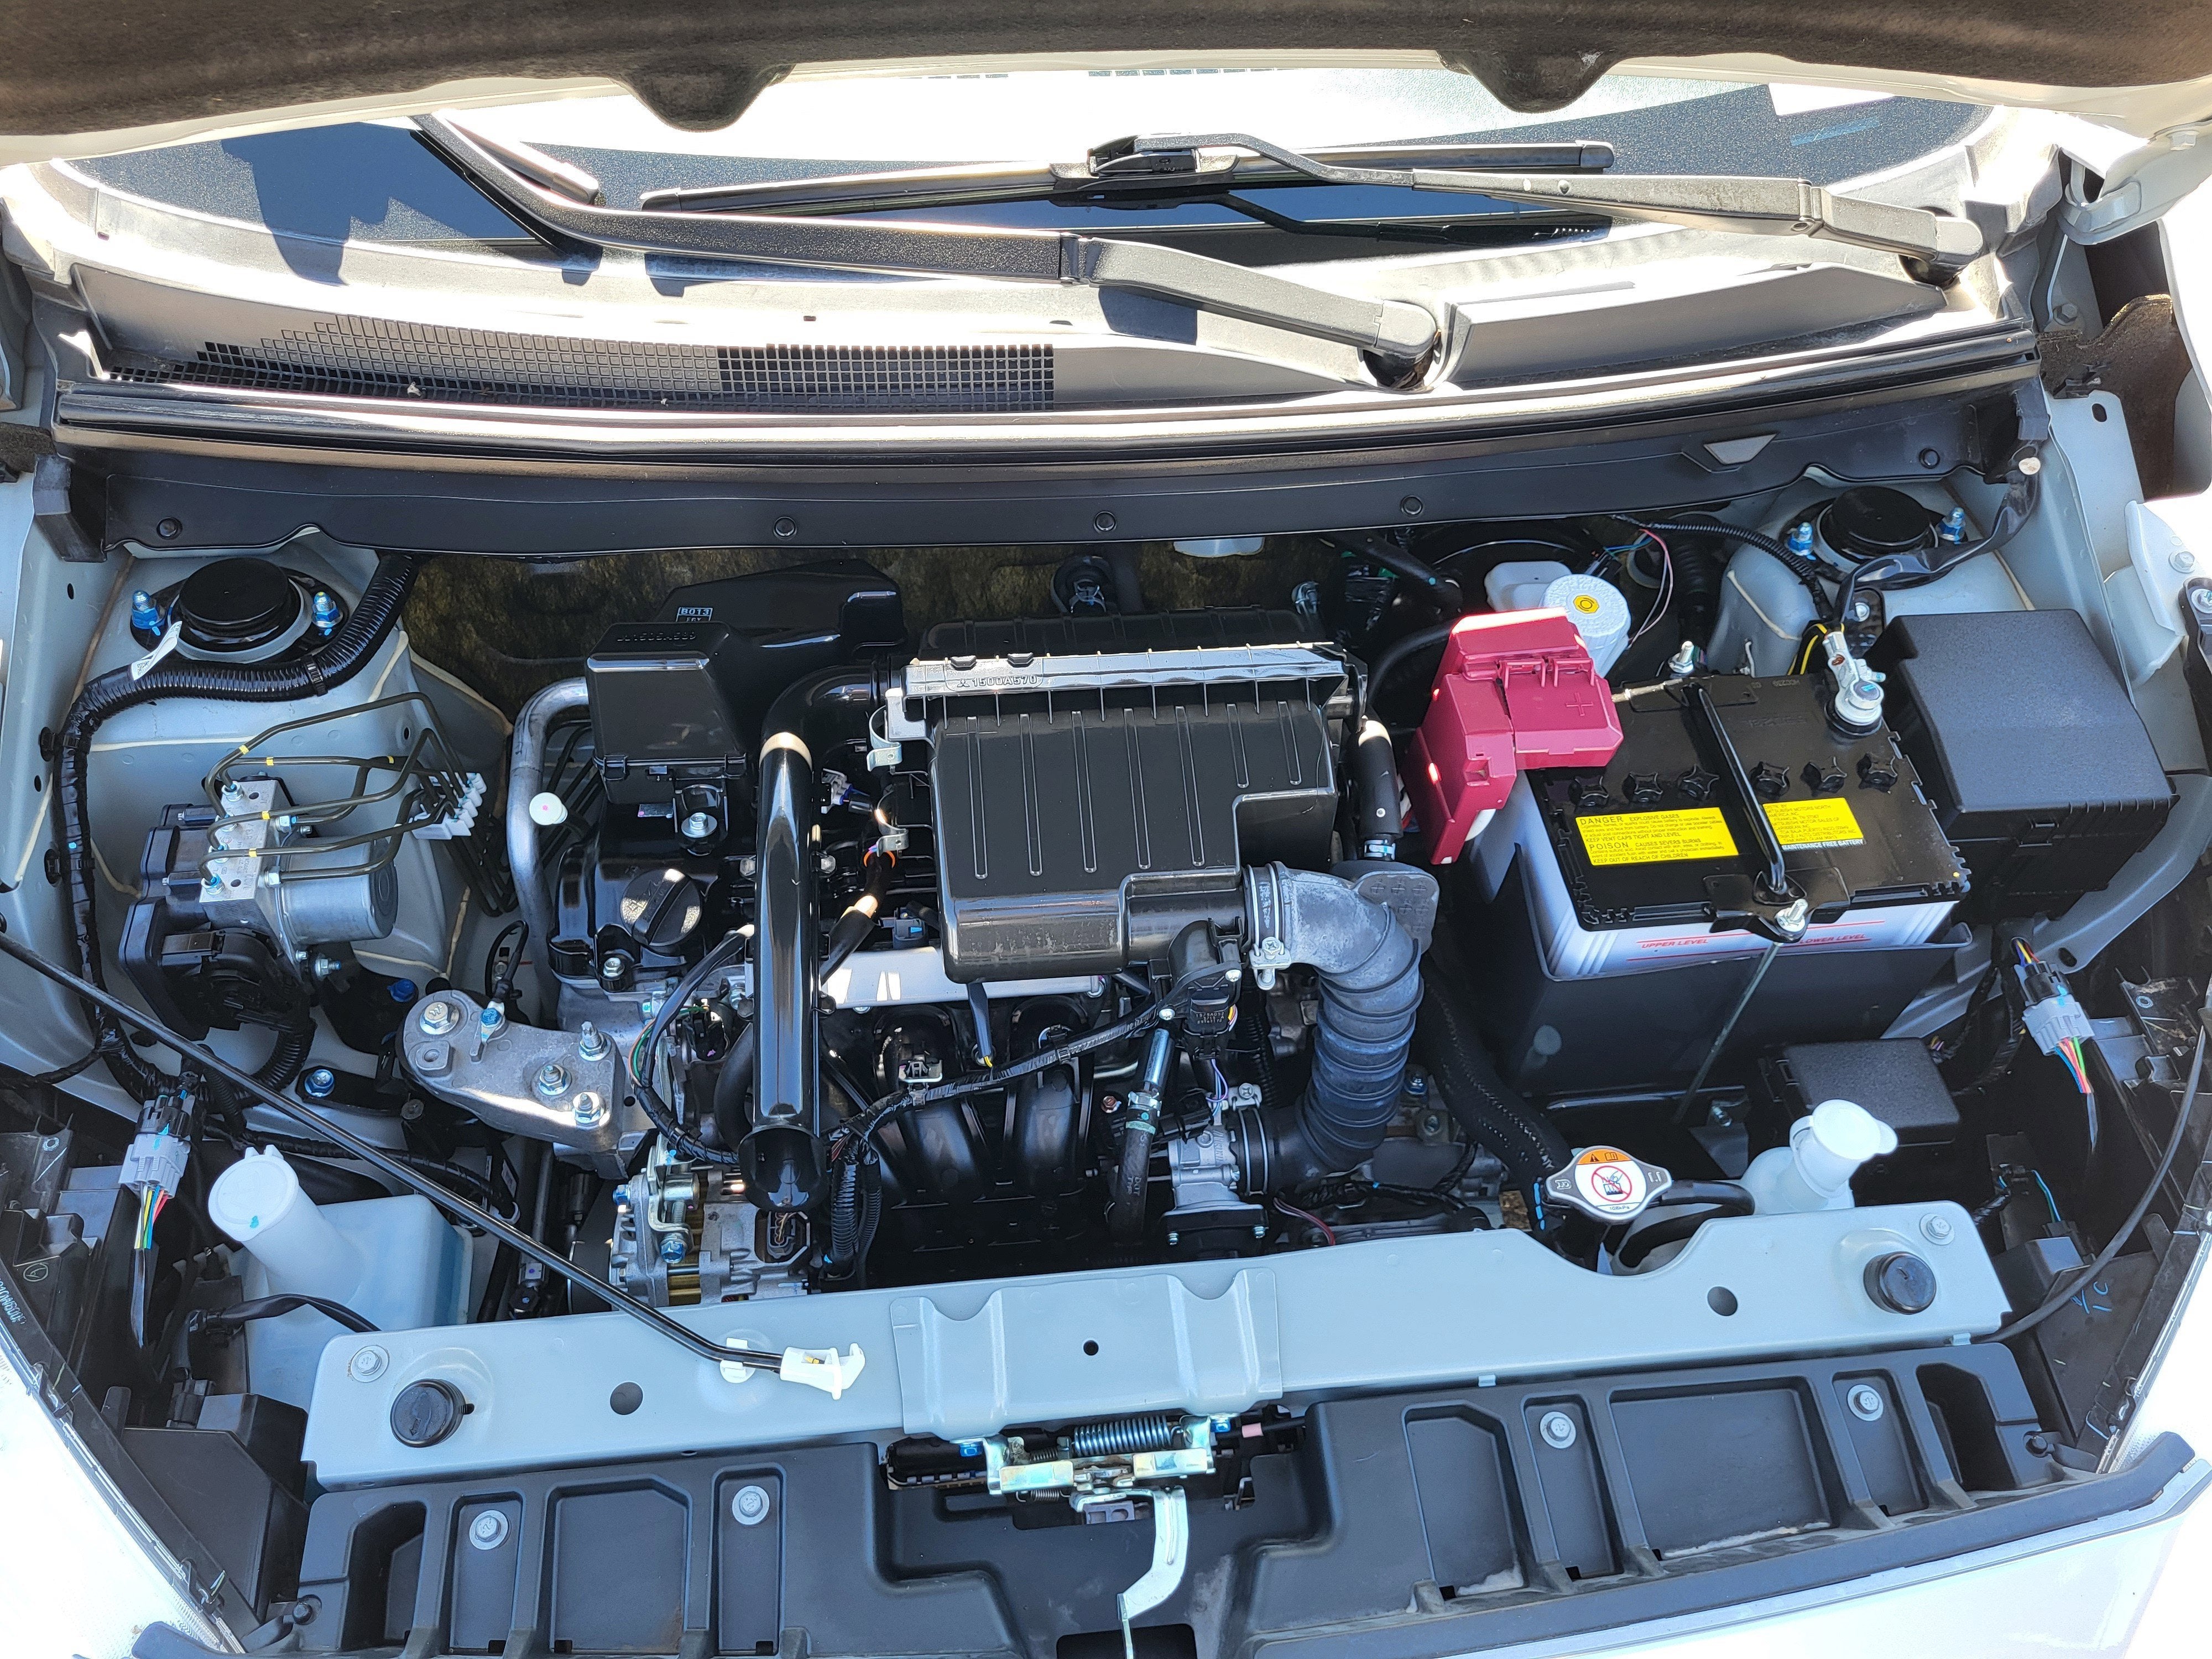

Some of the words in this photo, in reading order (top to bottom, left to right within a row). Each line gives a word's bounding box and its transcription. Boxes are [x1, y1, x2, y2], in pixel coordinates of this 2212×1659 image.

[972, 674, 1037, 687] 1500A570
[1579, 816, 1624, 825] DANGER
[1588, 842, 1629, 850] POISON
[1647, 1171, 1661, 1183] 1.1
